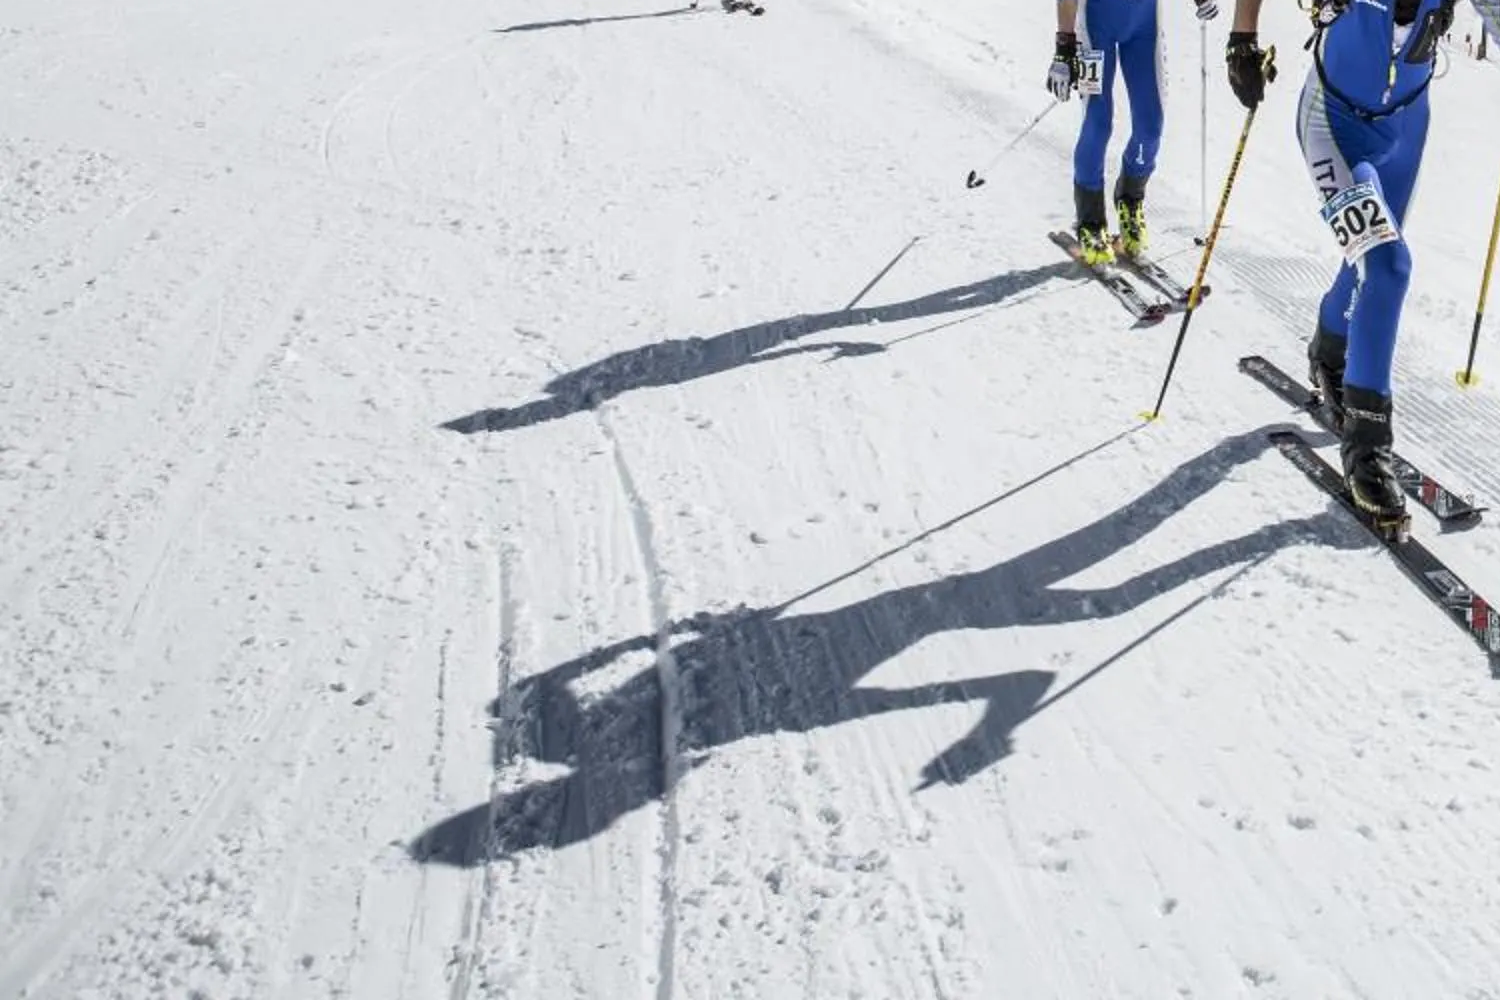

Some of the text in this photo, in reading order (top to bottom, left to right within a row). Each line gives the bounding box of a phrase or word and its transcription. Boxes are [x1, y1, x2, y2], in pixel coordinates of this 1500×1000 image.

[1077, 60, 1099, 82] 01
[1312, 158, 1339, 202] ITA
[1330, 198, 1387, 247] 502
